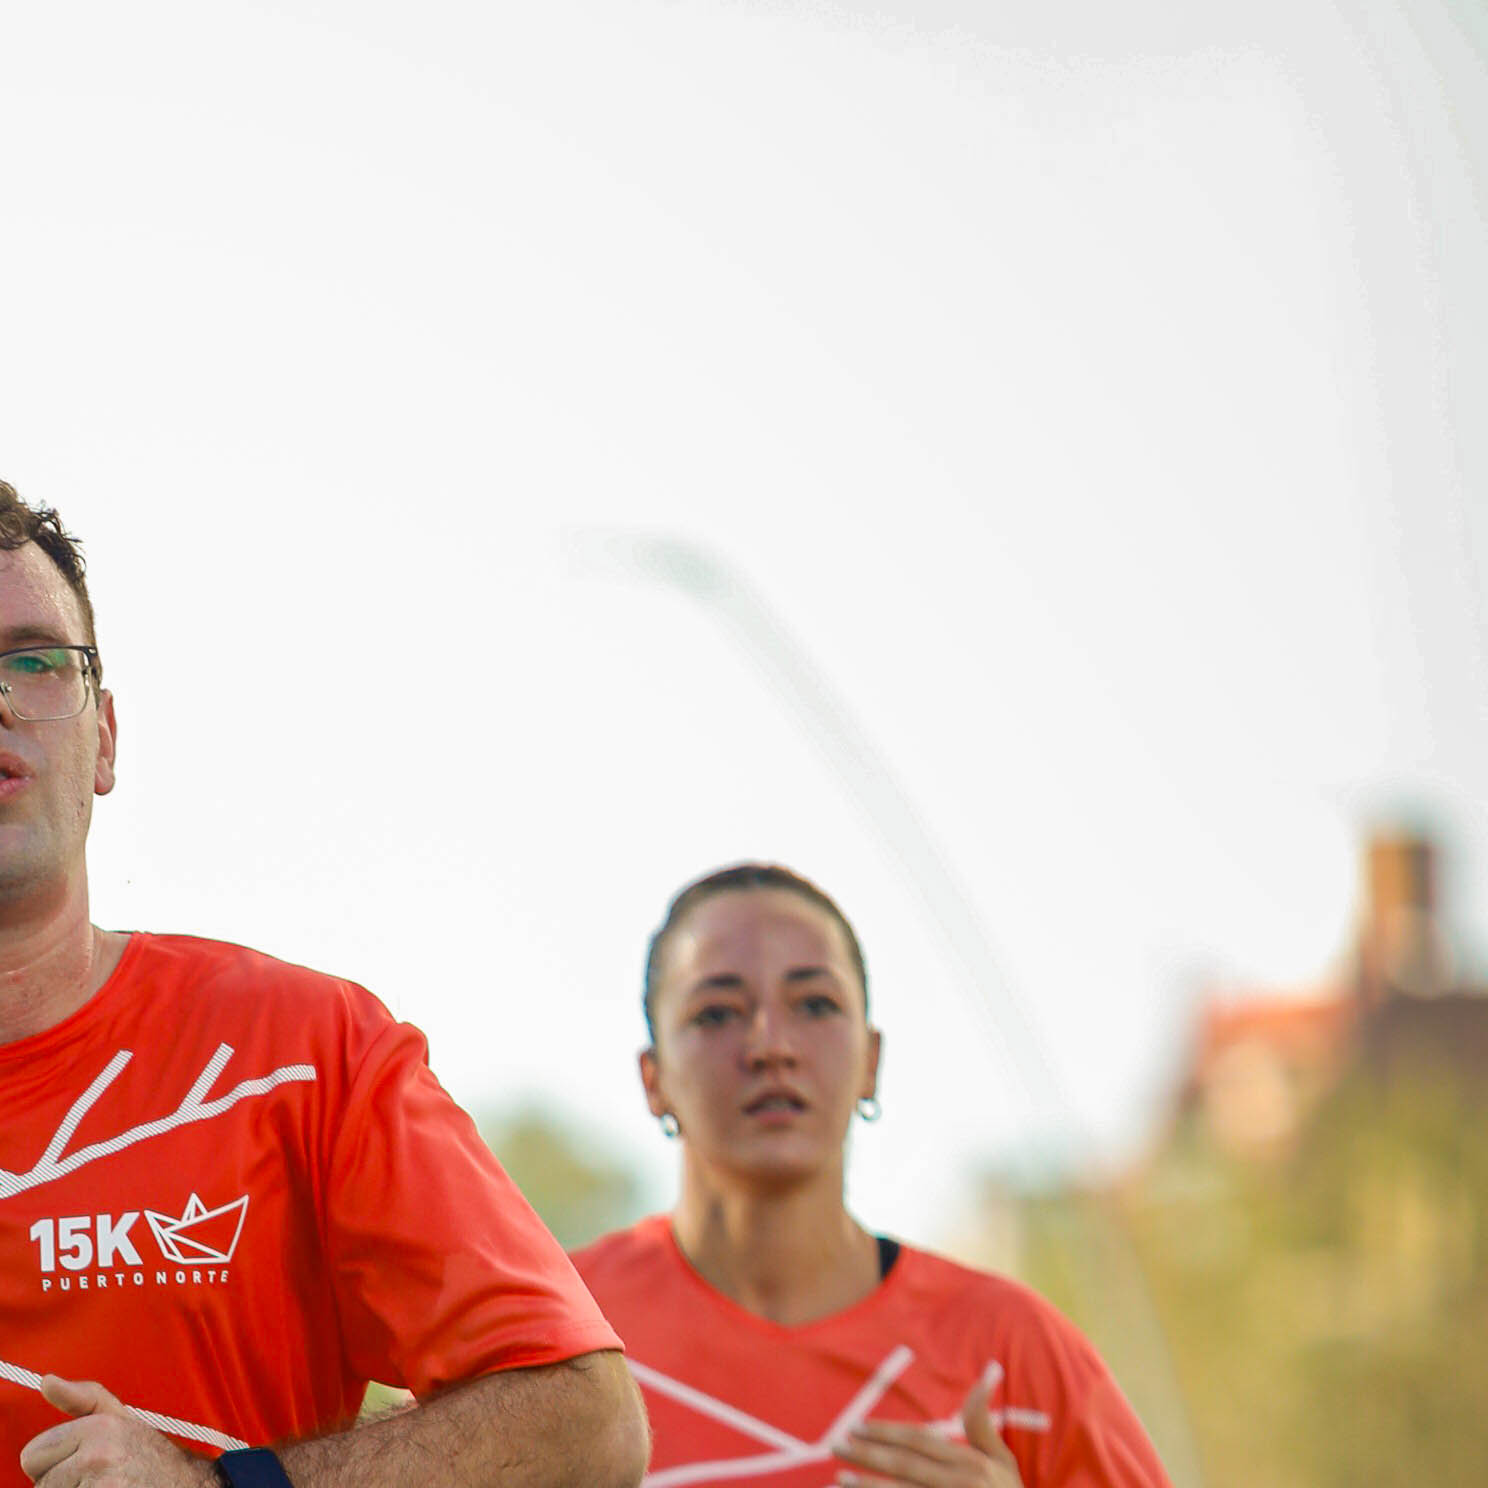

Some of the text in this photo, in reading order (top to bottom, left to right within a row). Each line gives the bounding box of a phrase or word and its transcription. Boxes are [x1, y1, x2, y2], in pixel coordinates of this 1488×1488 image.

[29, 1211, 144, 1273] 15K
[42, 1270, 229, 1292] PUERTO NORTE
